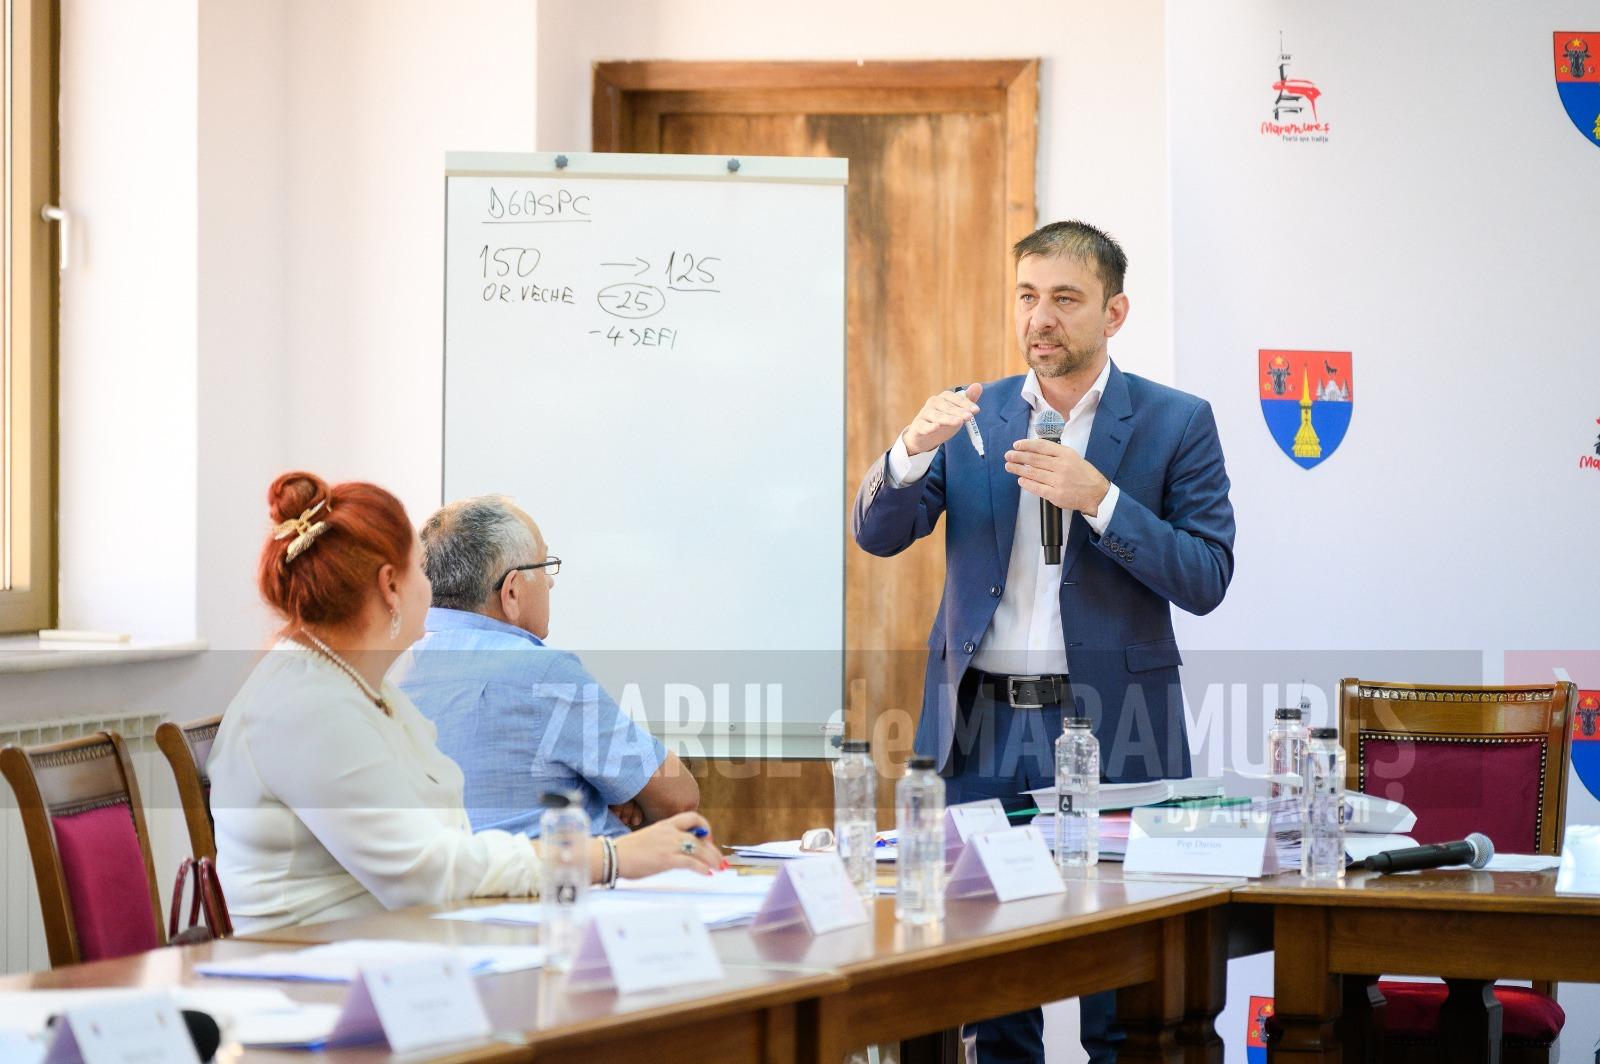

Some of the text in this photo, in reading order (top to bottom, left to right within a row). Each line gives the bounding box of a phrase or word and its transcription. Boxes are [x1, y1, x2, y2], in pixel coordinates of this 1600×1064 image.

[480, 245, 721, 284] 150 125
[521, 286, 575, 304] VECHE
